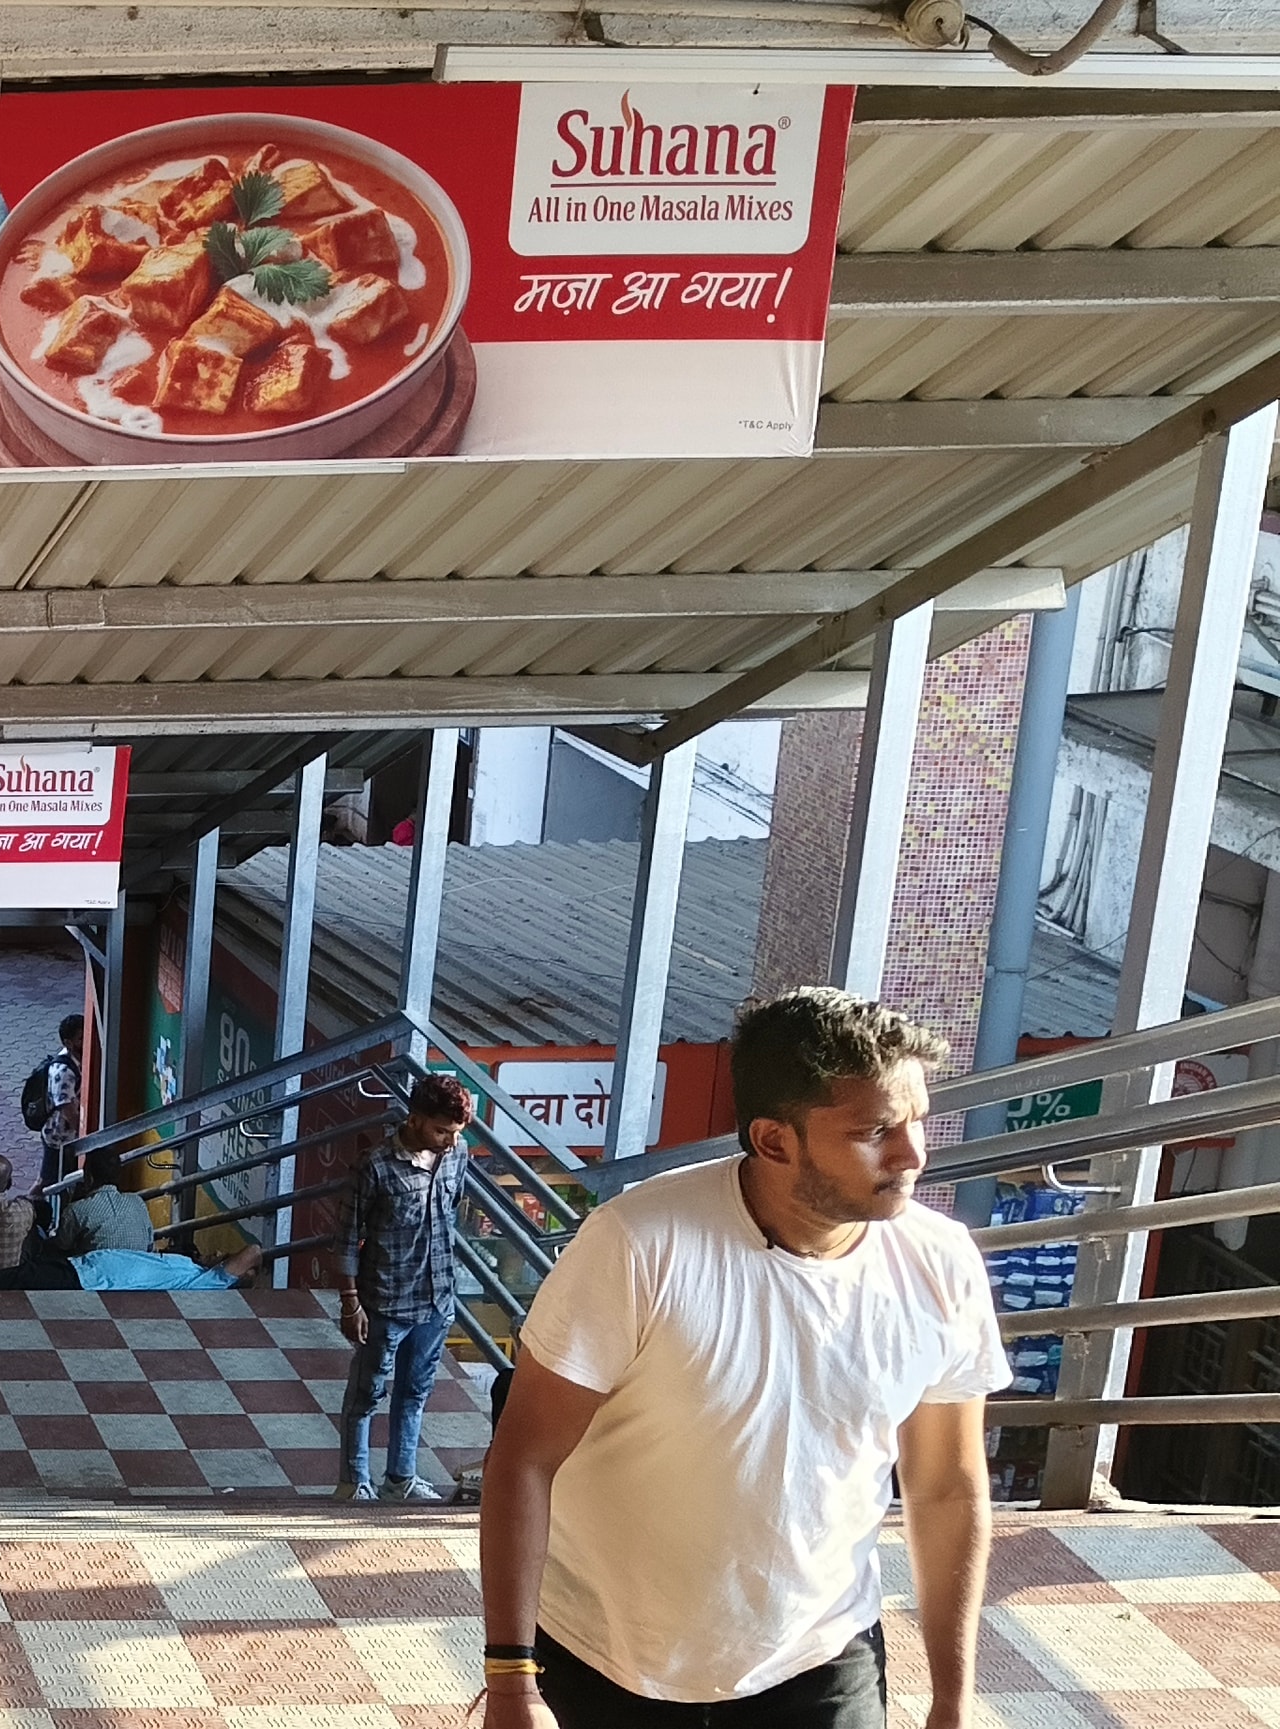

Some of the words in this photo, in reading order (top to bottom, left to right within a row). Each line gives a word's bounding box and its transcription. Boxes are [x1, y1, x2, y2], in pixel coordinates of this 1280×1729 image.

[552, 104, 777, 178] Suhana
[528, 196, 559, 223] All
[567, 196, 586, 222] in
[593, 195, 635, 222] One
[640, 195, 720, 221] Masala
[724, 194, 793, 221] Mixes
[611, 271, 681, 315] आ
[766, 419, 793, 432] Apply
[8, 800, 28, 812] One
[30, 800, 67, 812] Masala
[70, 800, 102, 812] Mixes
[17, 832, 51, 852] आ
